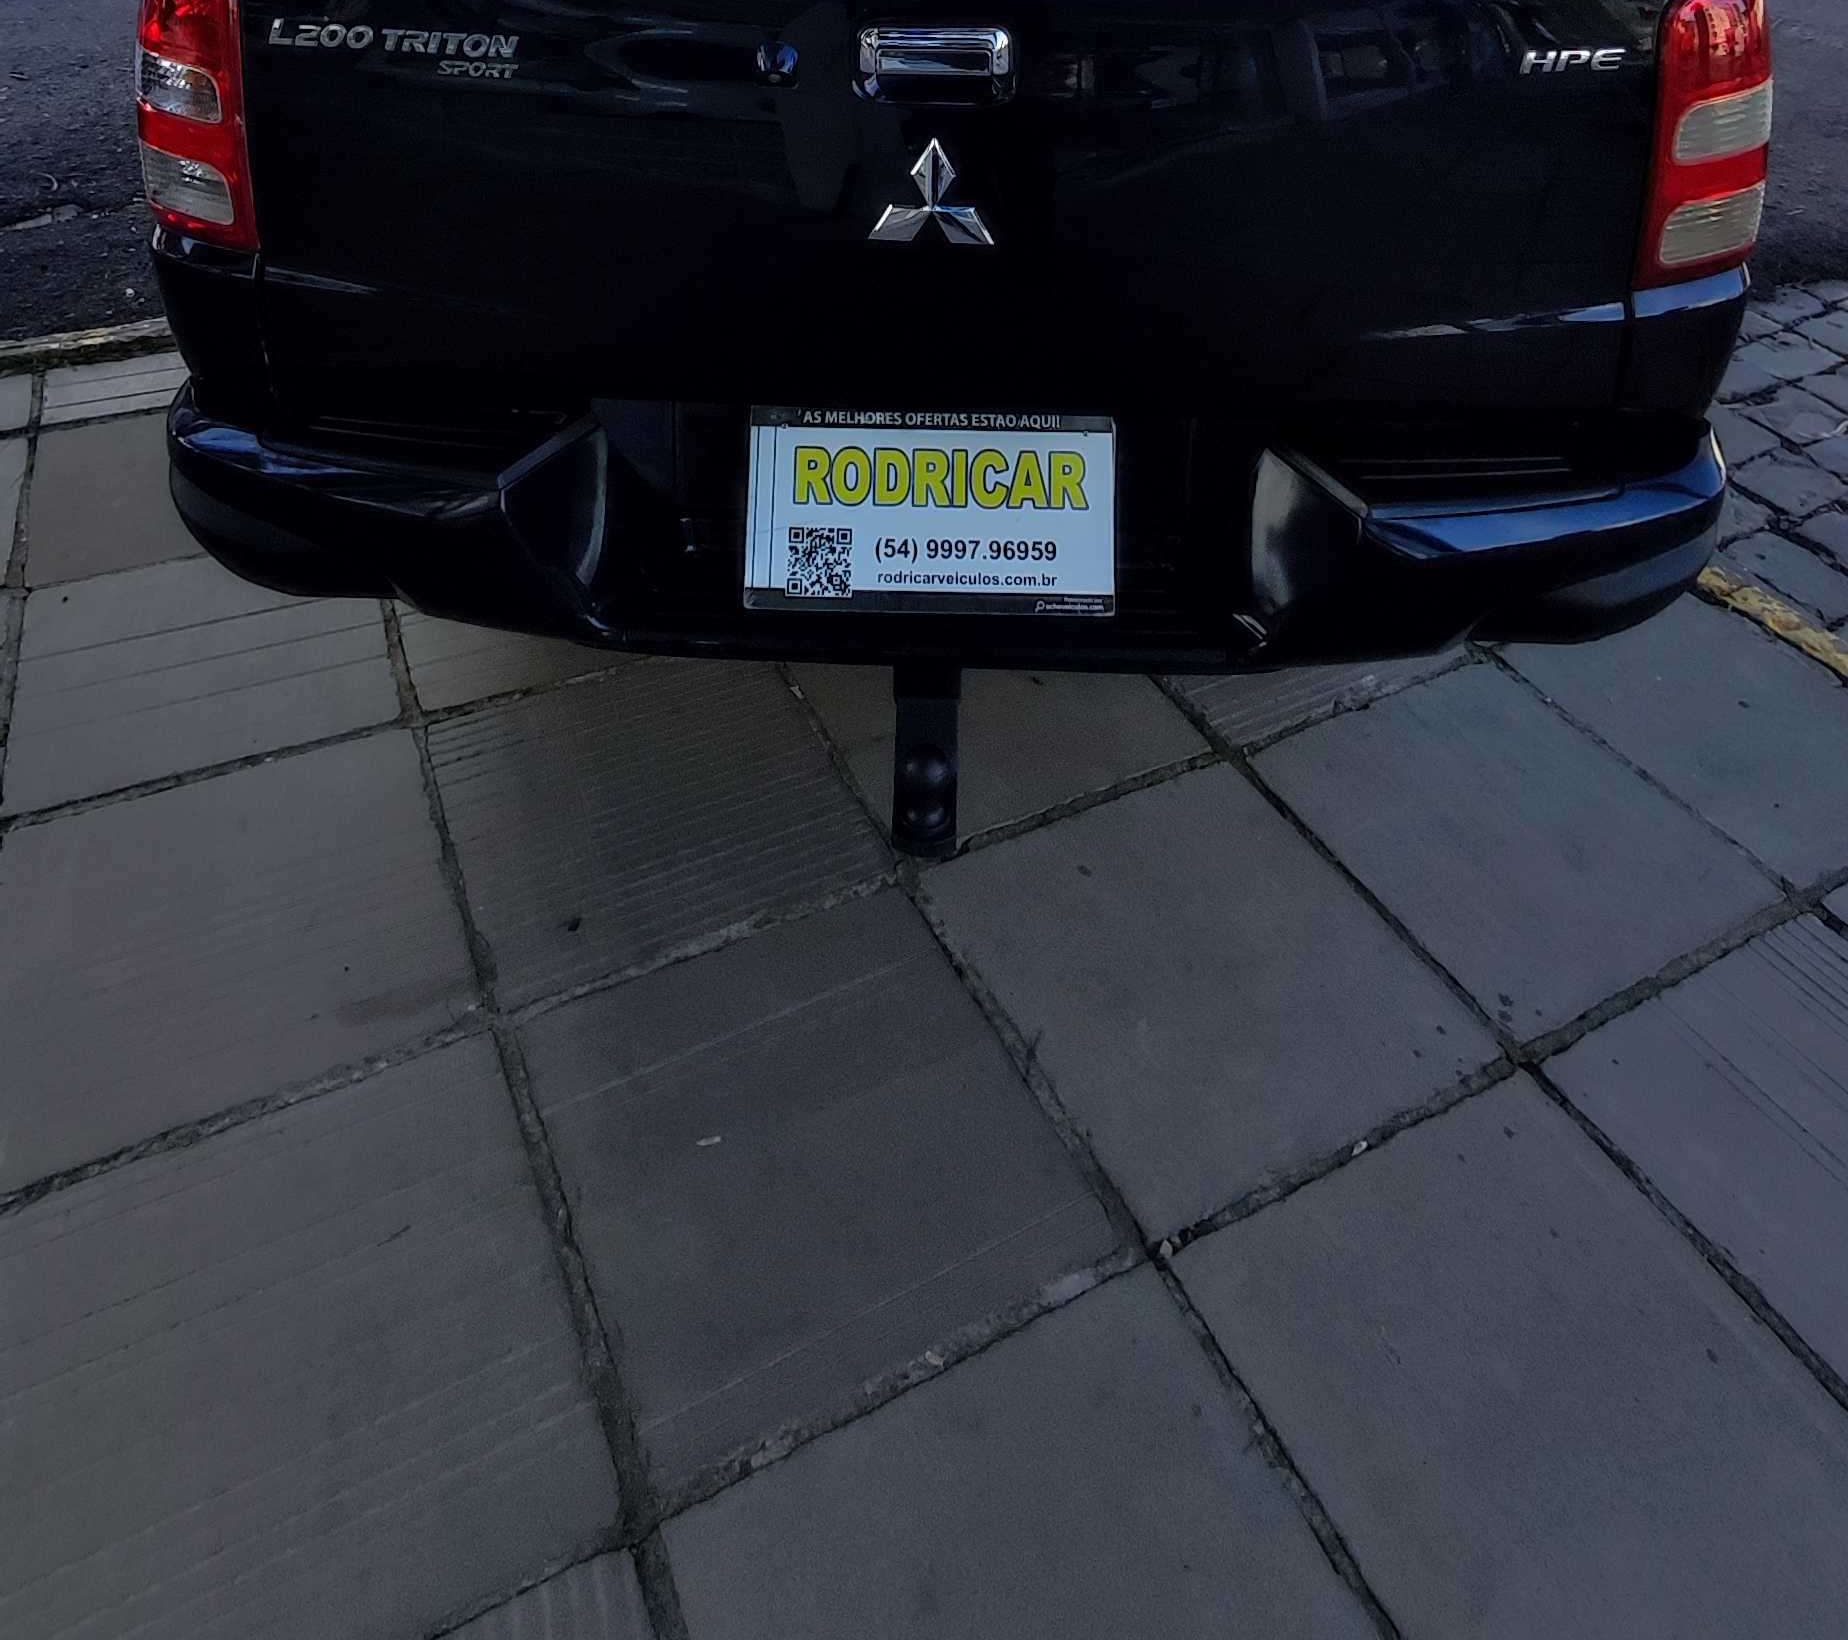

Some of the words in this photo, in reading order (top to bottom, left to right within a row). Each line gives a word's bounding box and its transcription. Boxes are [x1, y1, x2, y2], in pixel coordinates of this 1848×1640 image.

[268, 17, 374, 49] L200
[381, 28, 519, 58] TRITON
[437, 60, 519, 79] SPORT
[1519, 47, 1627, 75] HPE
[803, 411, 822, 424] AS
[825, 411, 902, 426] MELHORES
[905, 413, 968, 427] OFERTAS
[793, 445, 1090, 511] RODRICAR
[875, 537, 918, 564] (54)
[926, 538, 1058, 562] 9997.96959
[877, 570, 1059, 588] rodricarveiculos.com.br
